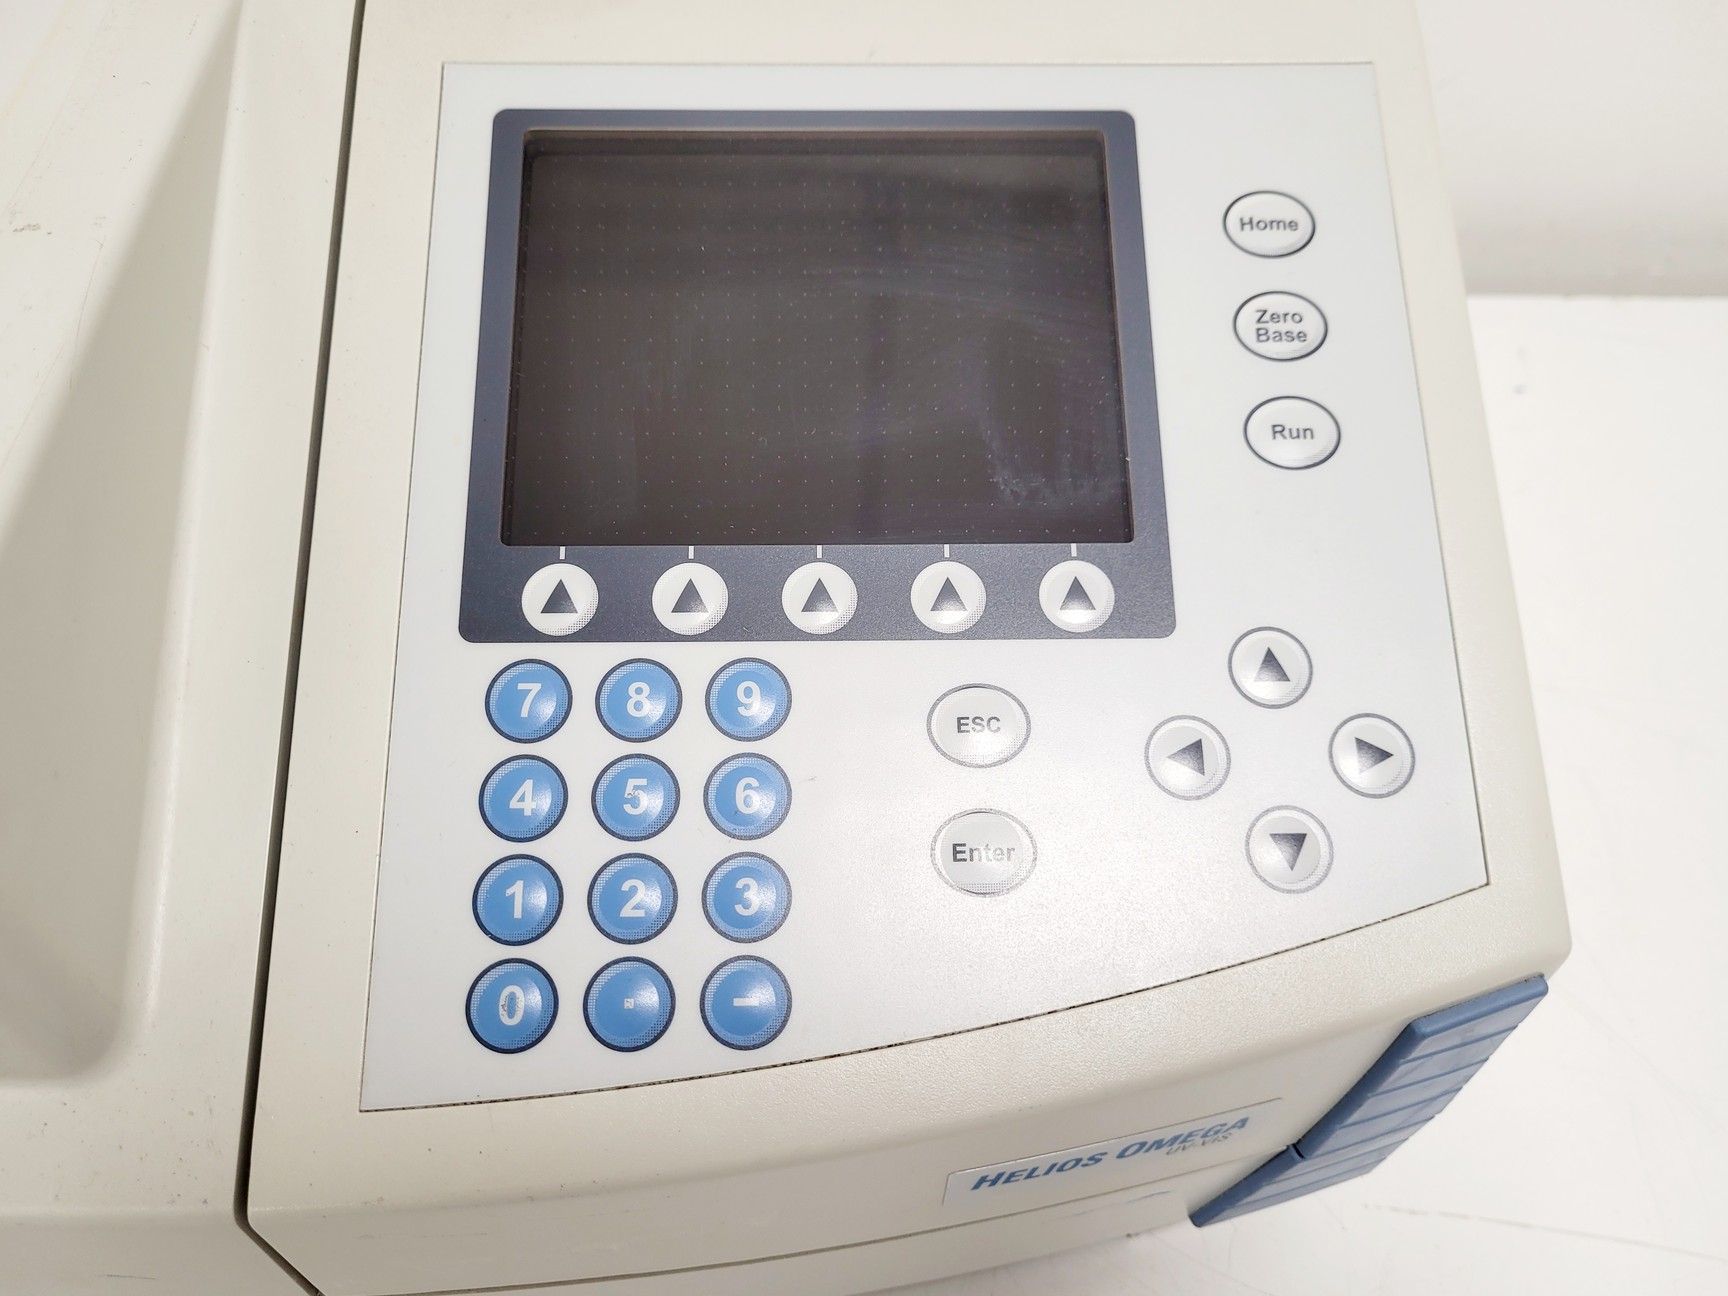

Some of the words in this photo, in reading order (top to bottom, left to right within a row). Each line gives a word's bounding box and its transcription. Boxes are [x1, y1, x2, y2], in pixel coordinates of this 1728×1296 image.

[1240, 217, 1298, 231] Home
[1255, 309, 1303, 324] Zero
[1255, 328, 1308, 343] Base
[1271, 424, 1314, 440] Run
[517, 683, 541, 717] 7
[626, 682, 650, 717] 8
[737, 681, 761, 716] 9
[956, 716, 1001, 734] ESC
[509, 779, 536, 816] 4
[623, 778, 648, 815] 5
[735, 777, 760, 813] 6
[952, 843, 1016, 863] Enter
[505, 880, 523, 919] 1
[620, 879, 645, 917] 2
[735, 878, 760, 915] 3
[499, 985, 524, 1025] 0
[971, 1152, 1108, 1191] HELIOS
[1116, 1117, 1250, 1160] OMEGA
